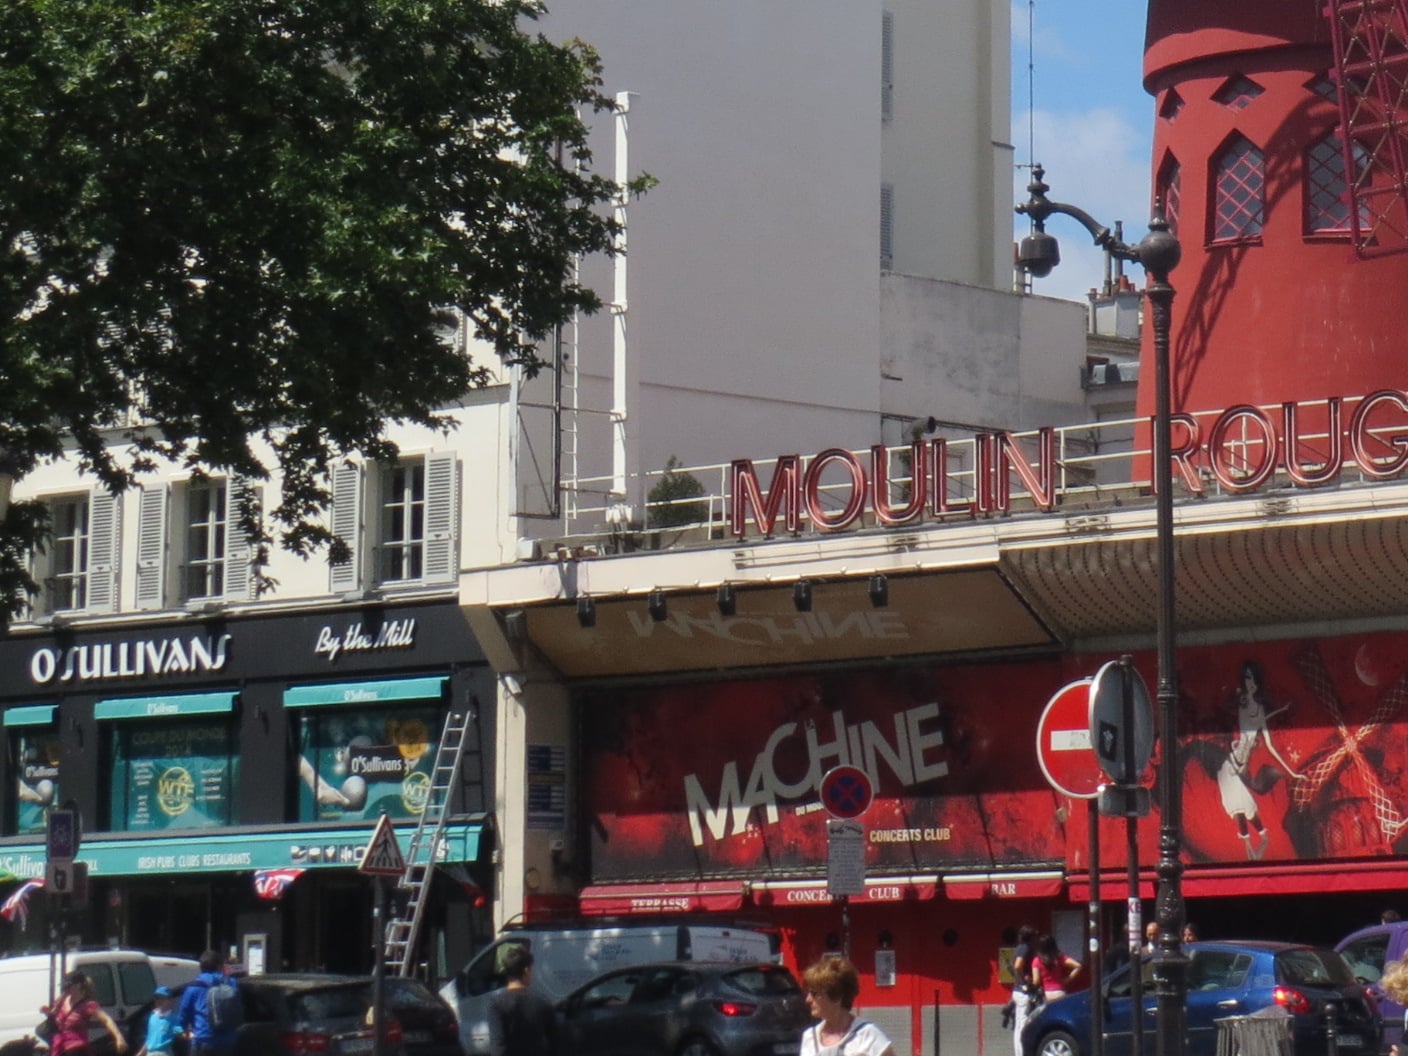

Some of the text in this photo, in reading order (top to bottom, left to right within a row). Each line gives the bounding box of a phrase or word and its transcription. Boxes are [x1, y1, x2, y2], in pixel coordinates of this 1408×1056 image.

[731, 426, 1055, 536] MOULIN
[31, 634, 232, 683] O'SULLIVANS
[315, 618, 415, 661] By the Mill
[351, 755, 402, 774] O'Sullivans
[684, 702, 949, 847] MACHINE
[869, 826, 951, 843] CONCERTS CLUB
[869, 887, 900, 900] CLUB
